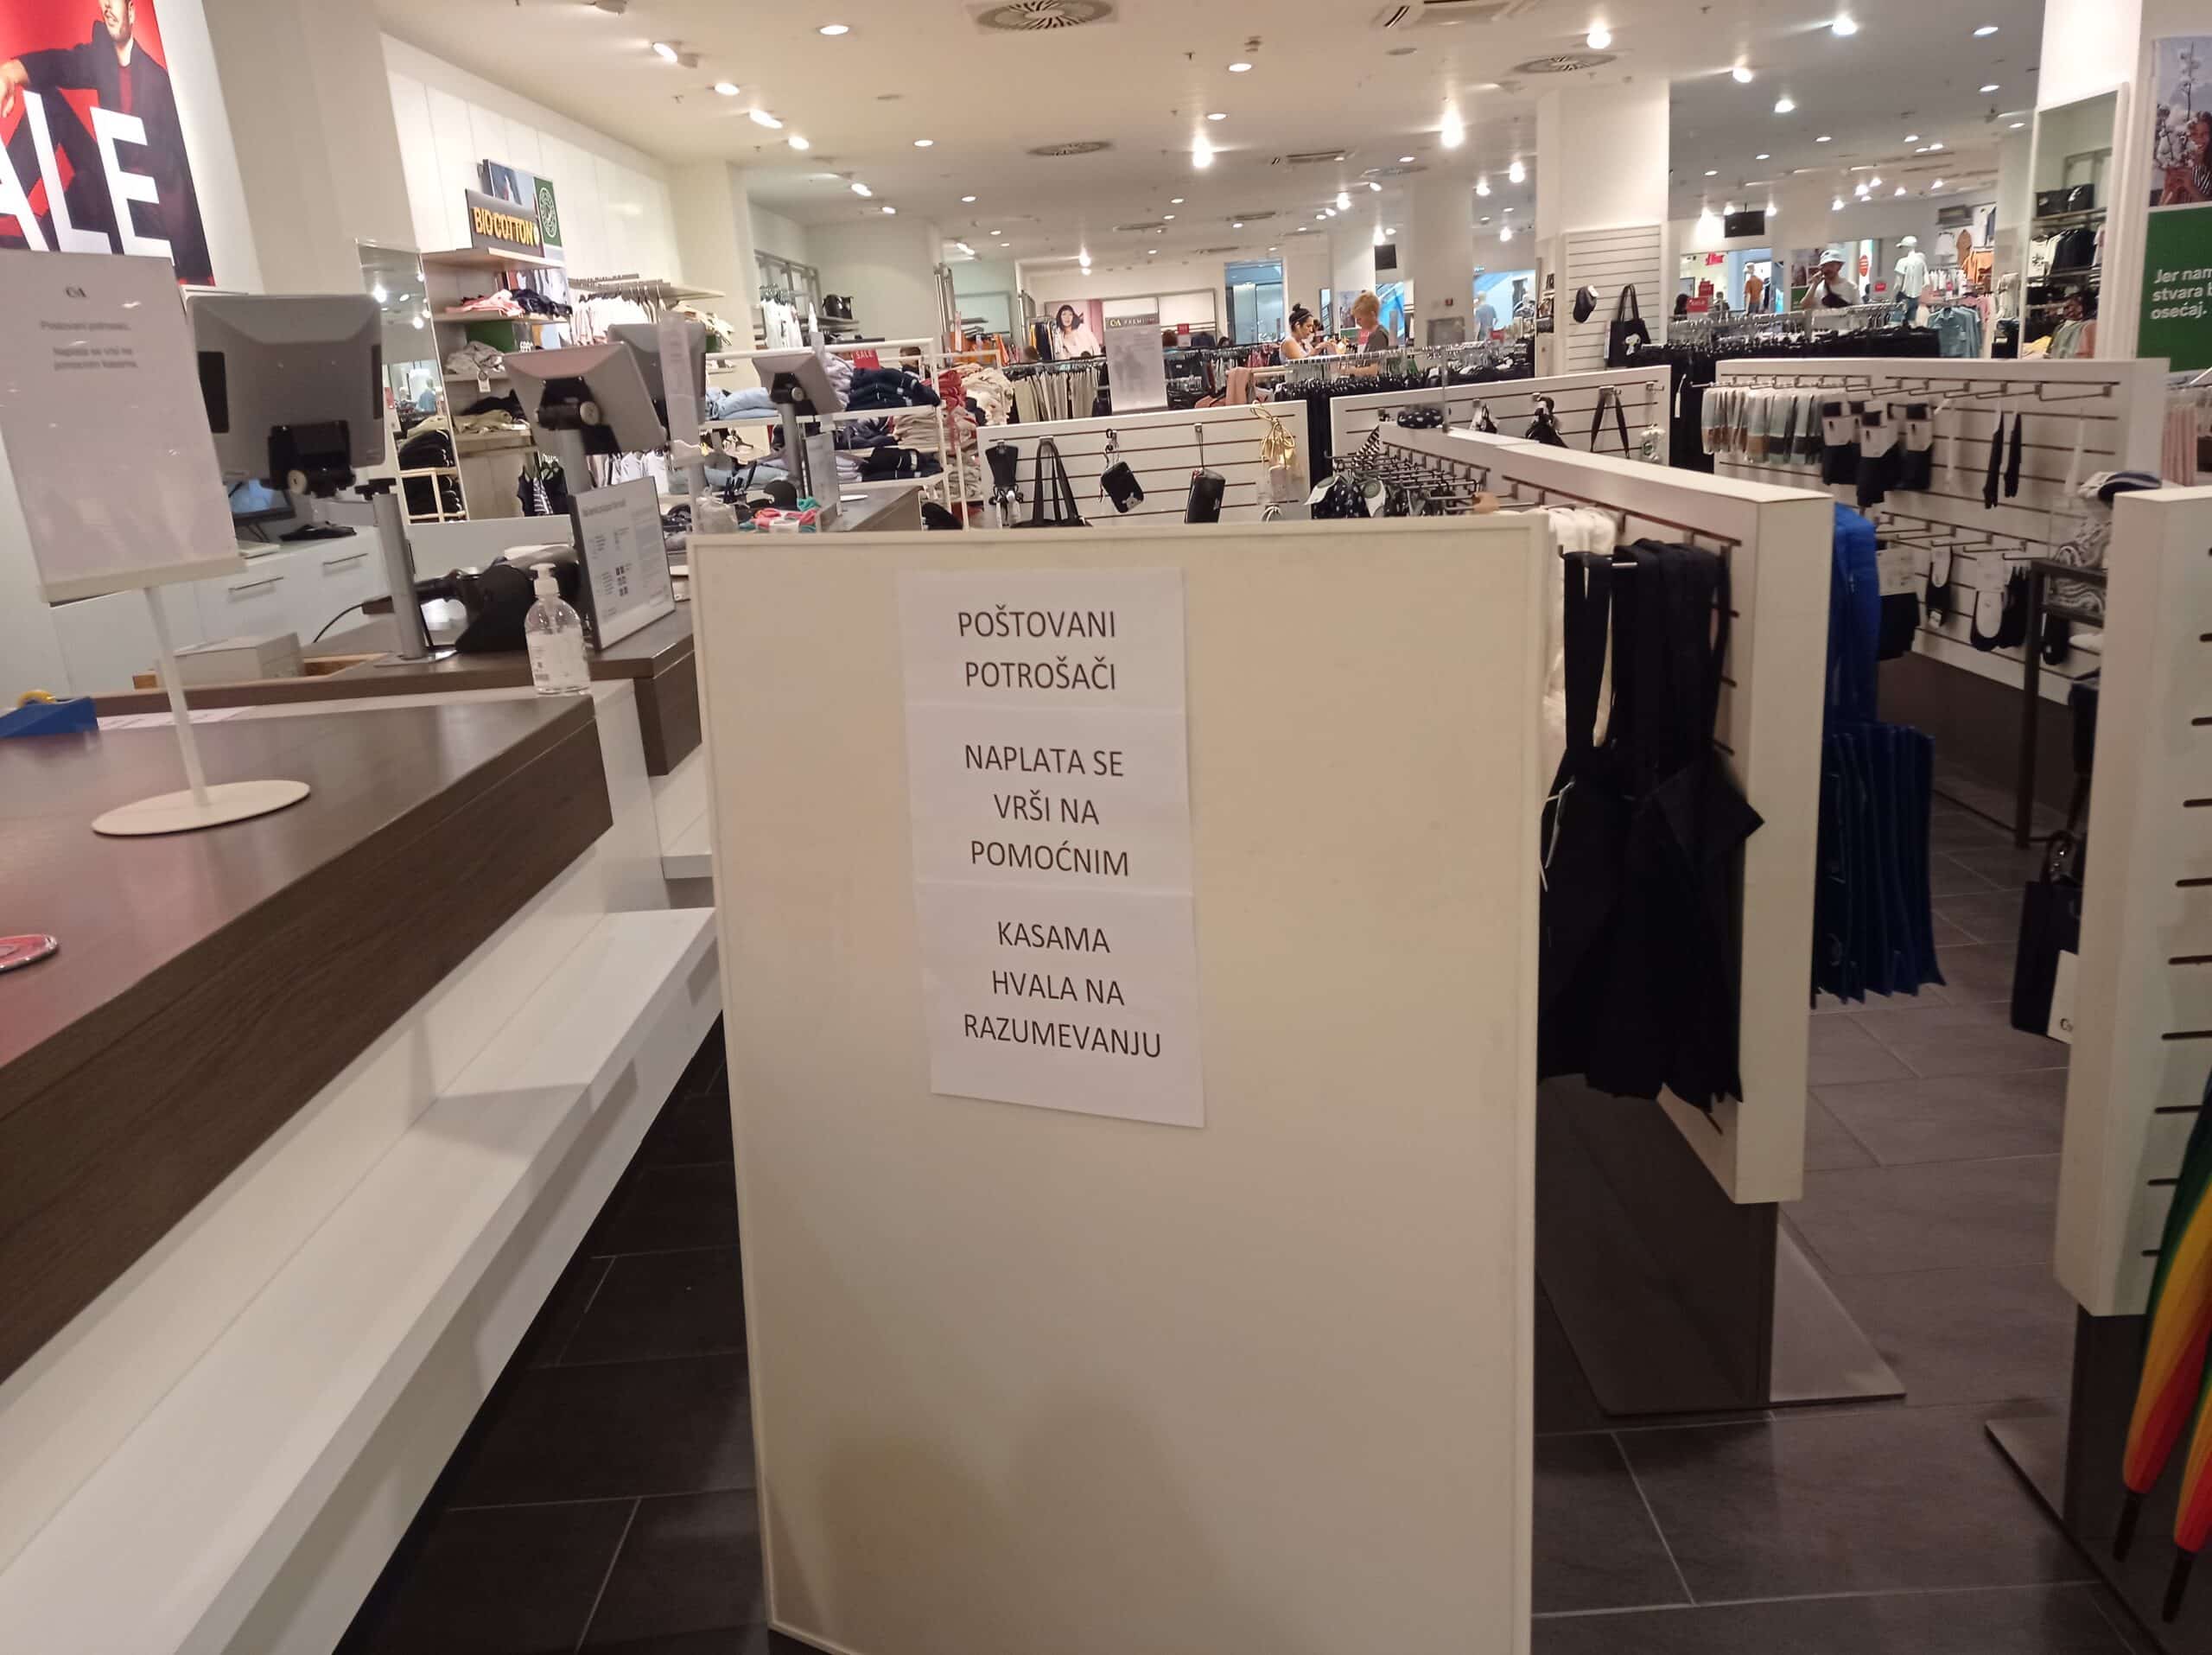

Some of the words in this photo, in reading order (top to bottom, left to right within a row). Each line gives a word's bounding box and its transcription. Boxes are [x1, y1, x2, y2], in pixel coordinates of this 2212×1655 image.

[473, 207, 493, 237] BIO
[492, 213, 534, 246] COTTON
[2153, 269, 2180, 284] Jer
[2150, 301, 2208, 320] osećaj.
[2152, 288, 2203, 302] stvara
[855, 349, 874, 360] SALE
[957, 603, 1116, 638] POŠTOVANI
[965, 655, 1116, 691] POTROŠAČI
[965, 744, 1086, 775] NAPLATA
[1093, 749, 1124, 777] SE
[993, 788, 1051, 822] VRŠI
[1060, 798, 1100, 825] NA
[971, 838, 1128, 877] POMOĆNIM
[997, 920, 1111, 954] KASAMA
[992, 970, 1078, 1002] HVALA
[1085, 978, 1125, 1006] NA
[963, 1013, 1161, 1059] RAZUMEVANJU
